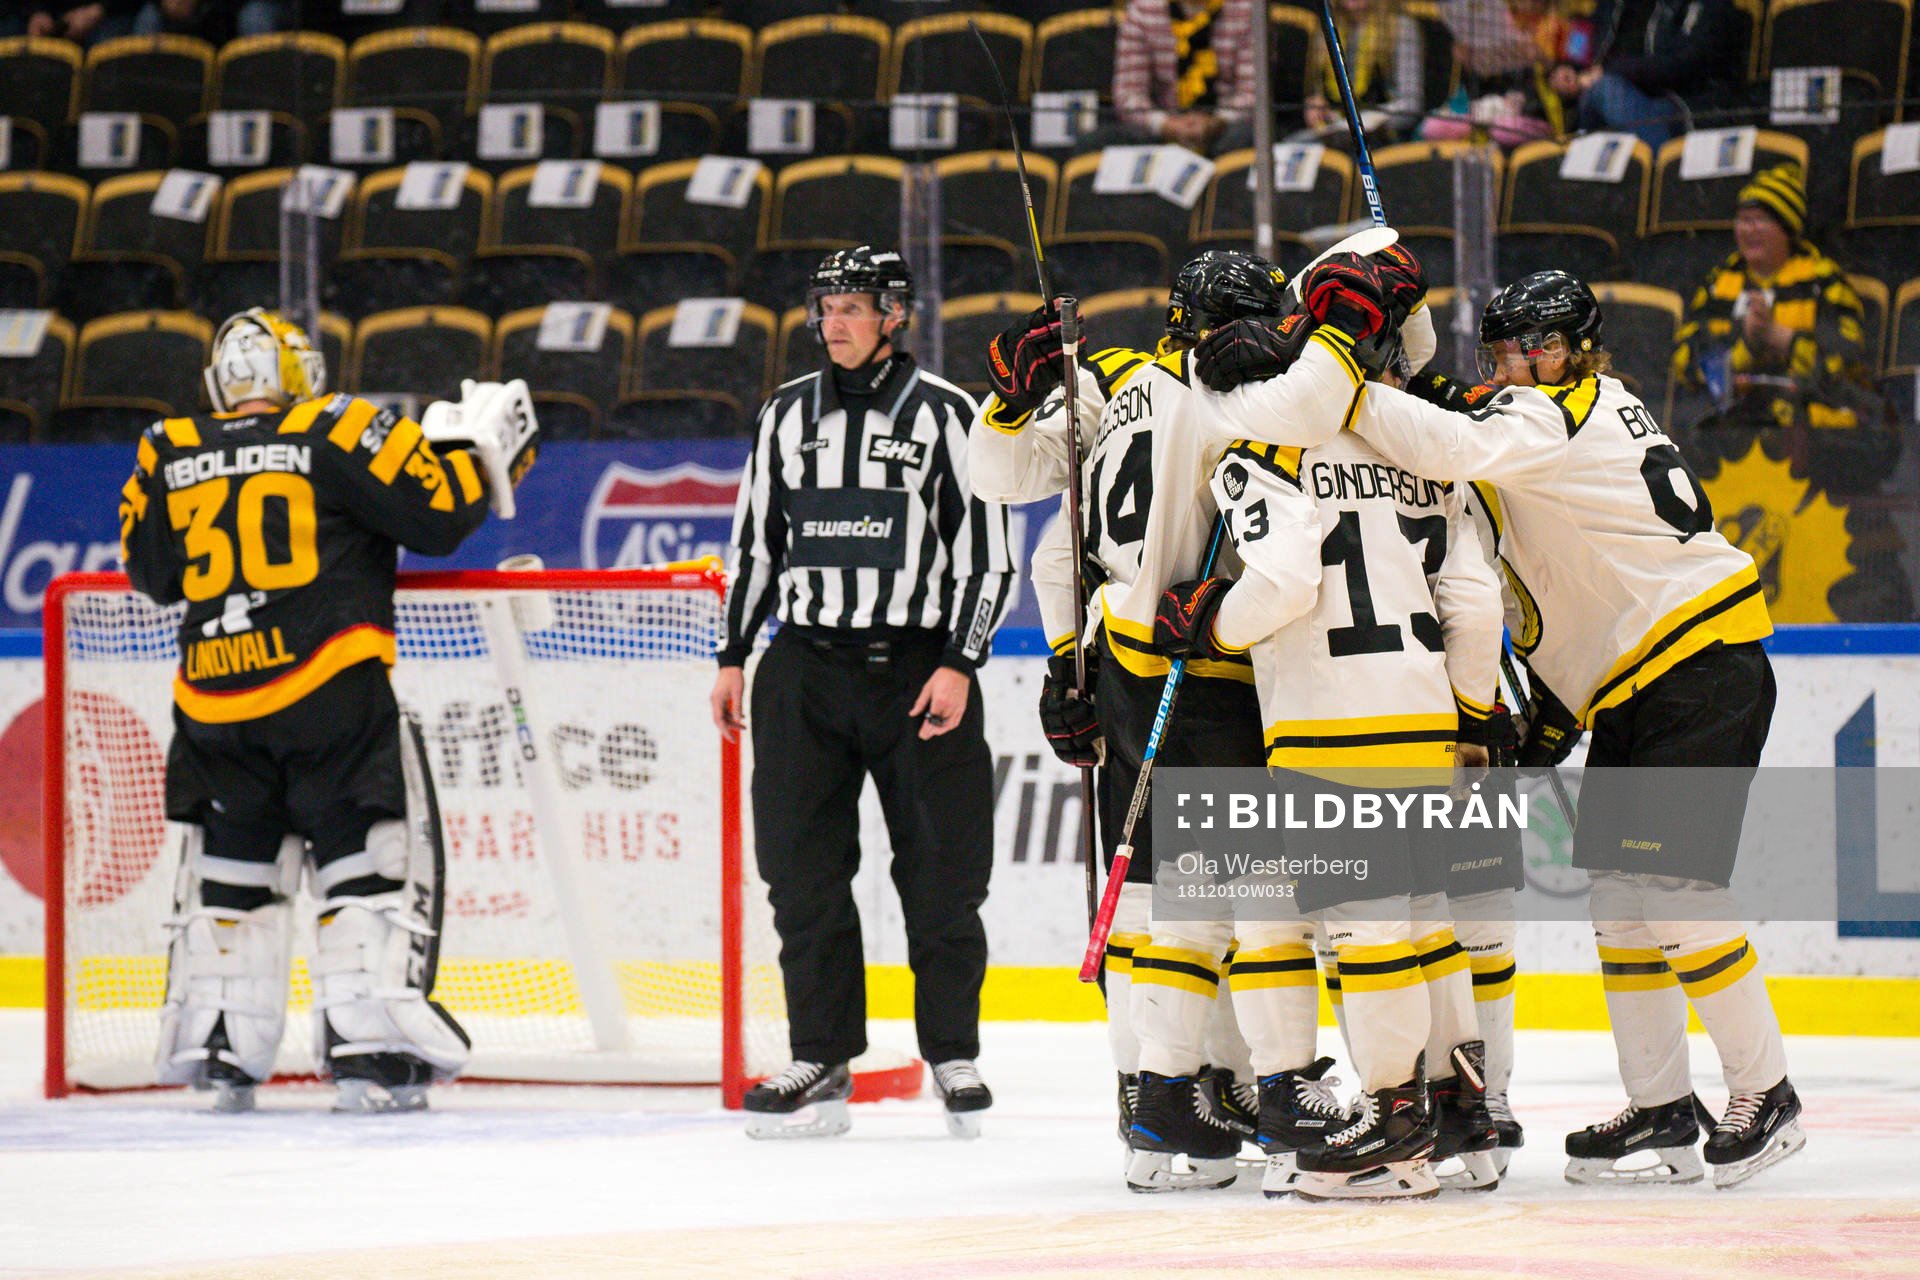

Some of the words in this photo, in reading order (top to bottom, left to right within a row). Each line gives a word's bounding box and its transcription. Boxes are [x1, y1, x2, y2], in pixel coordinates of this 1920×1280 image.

[1361, 174, 1385, 229] BAU
[173, 444, 312, 490] BOLIDEN
[869, 438, 921, 465] SHL
[166, 472, 319, 602] 30
[801, 515, 893, 539] swedol
[968, 598, 992, 652] CCM
[1149, 667, 1179, 750] BAUER
[1450, 856, 1503, 873] BAUER
[1620, 839, 1662, 852] BAUER
